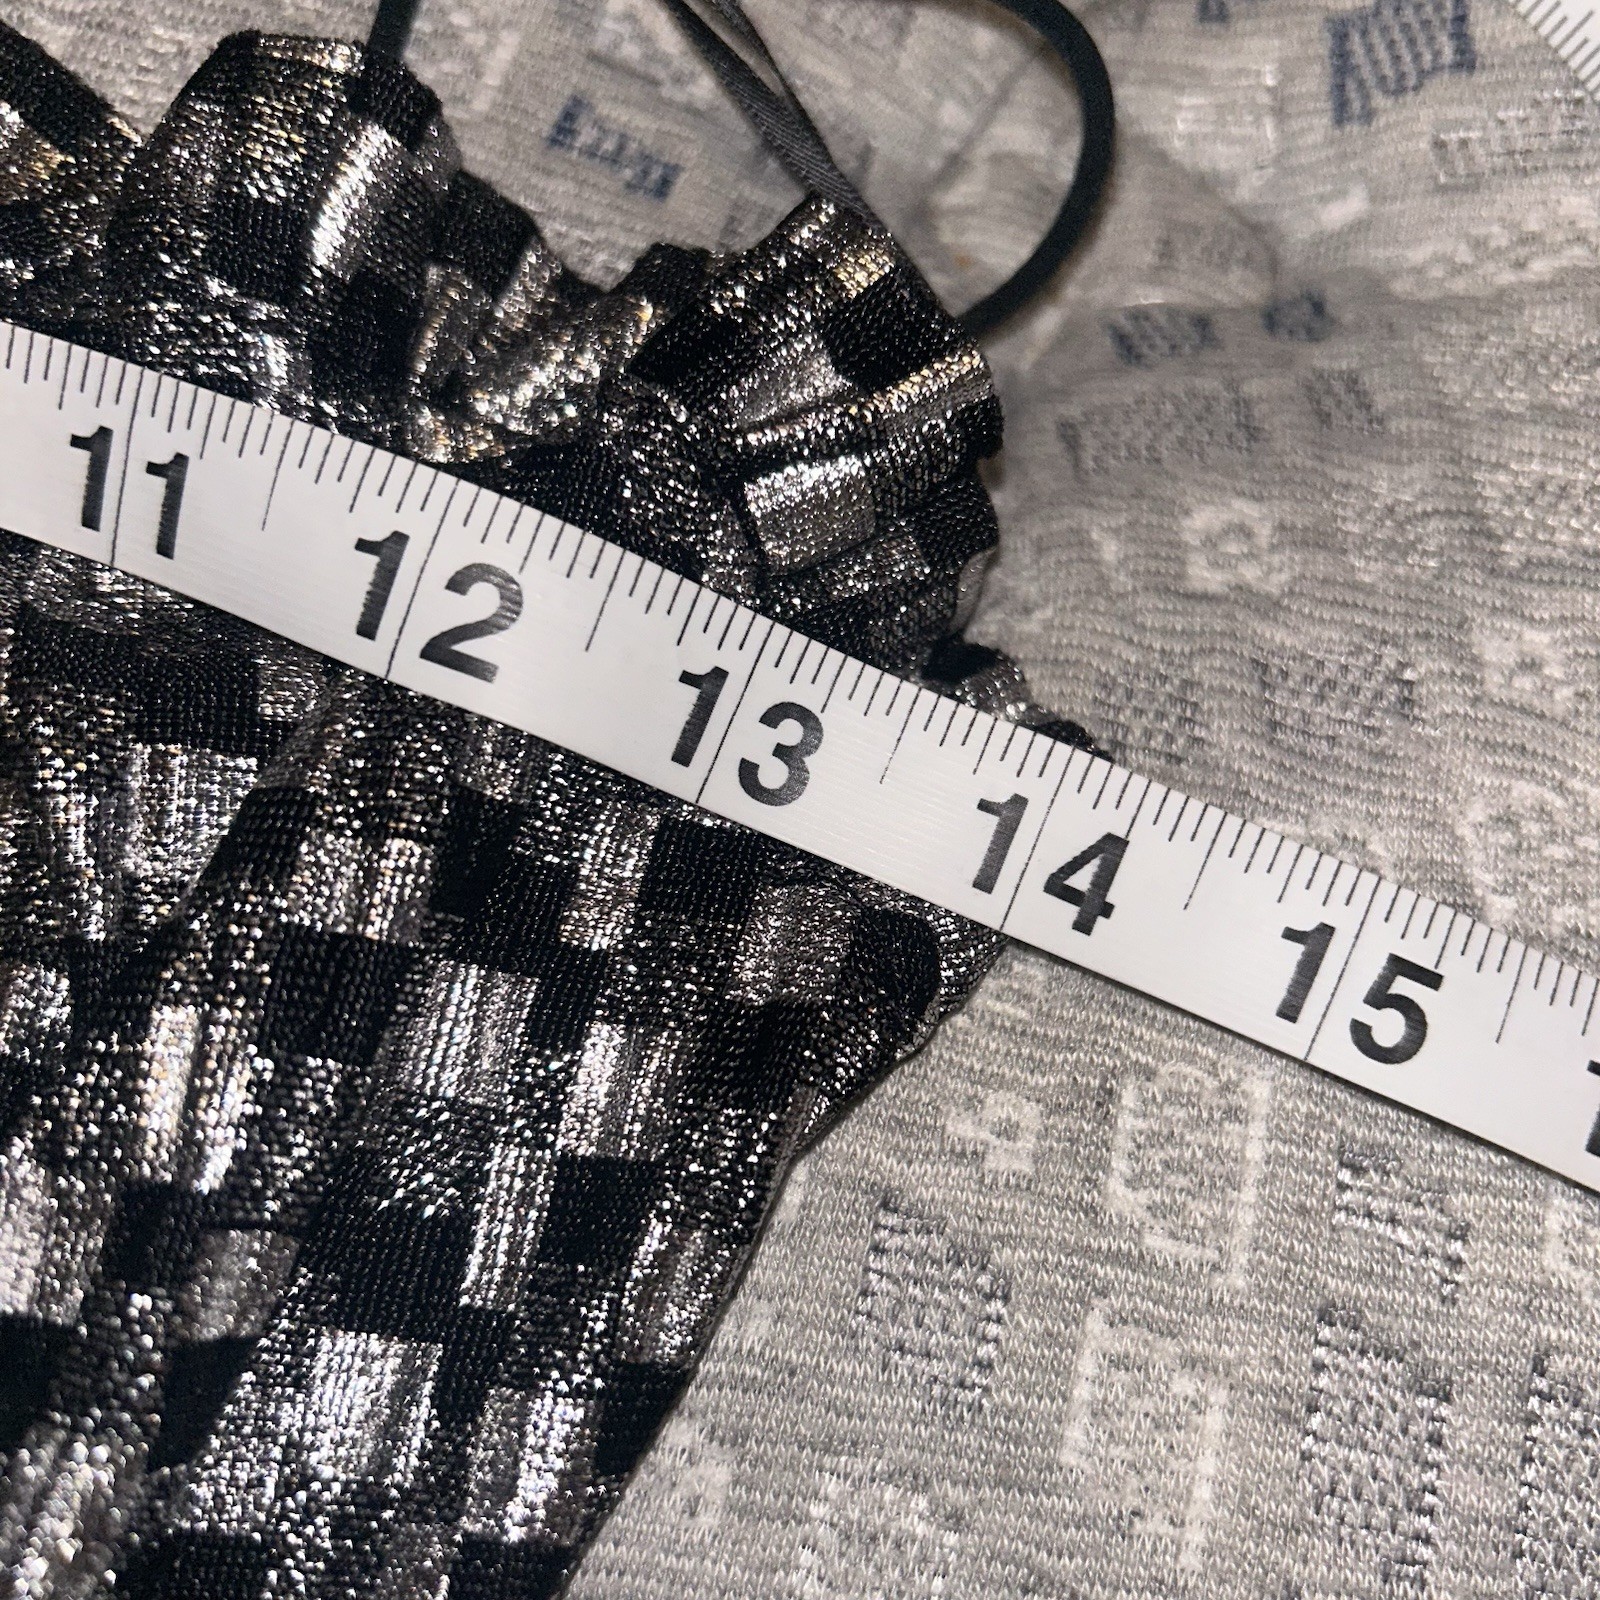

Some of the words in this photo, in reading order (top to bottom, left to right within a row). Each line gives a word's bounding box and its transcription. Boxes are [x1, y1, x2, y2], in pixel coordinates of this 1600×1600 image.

[69, 425, 190, 560] 11
[354, 530, 524, 684] 12
[670, 665, 824, 807] 13
[972, 793, 1130, 937] 14
[1276, 921, 1444, 1065] 15
